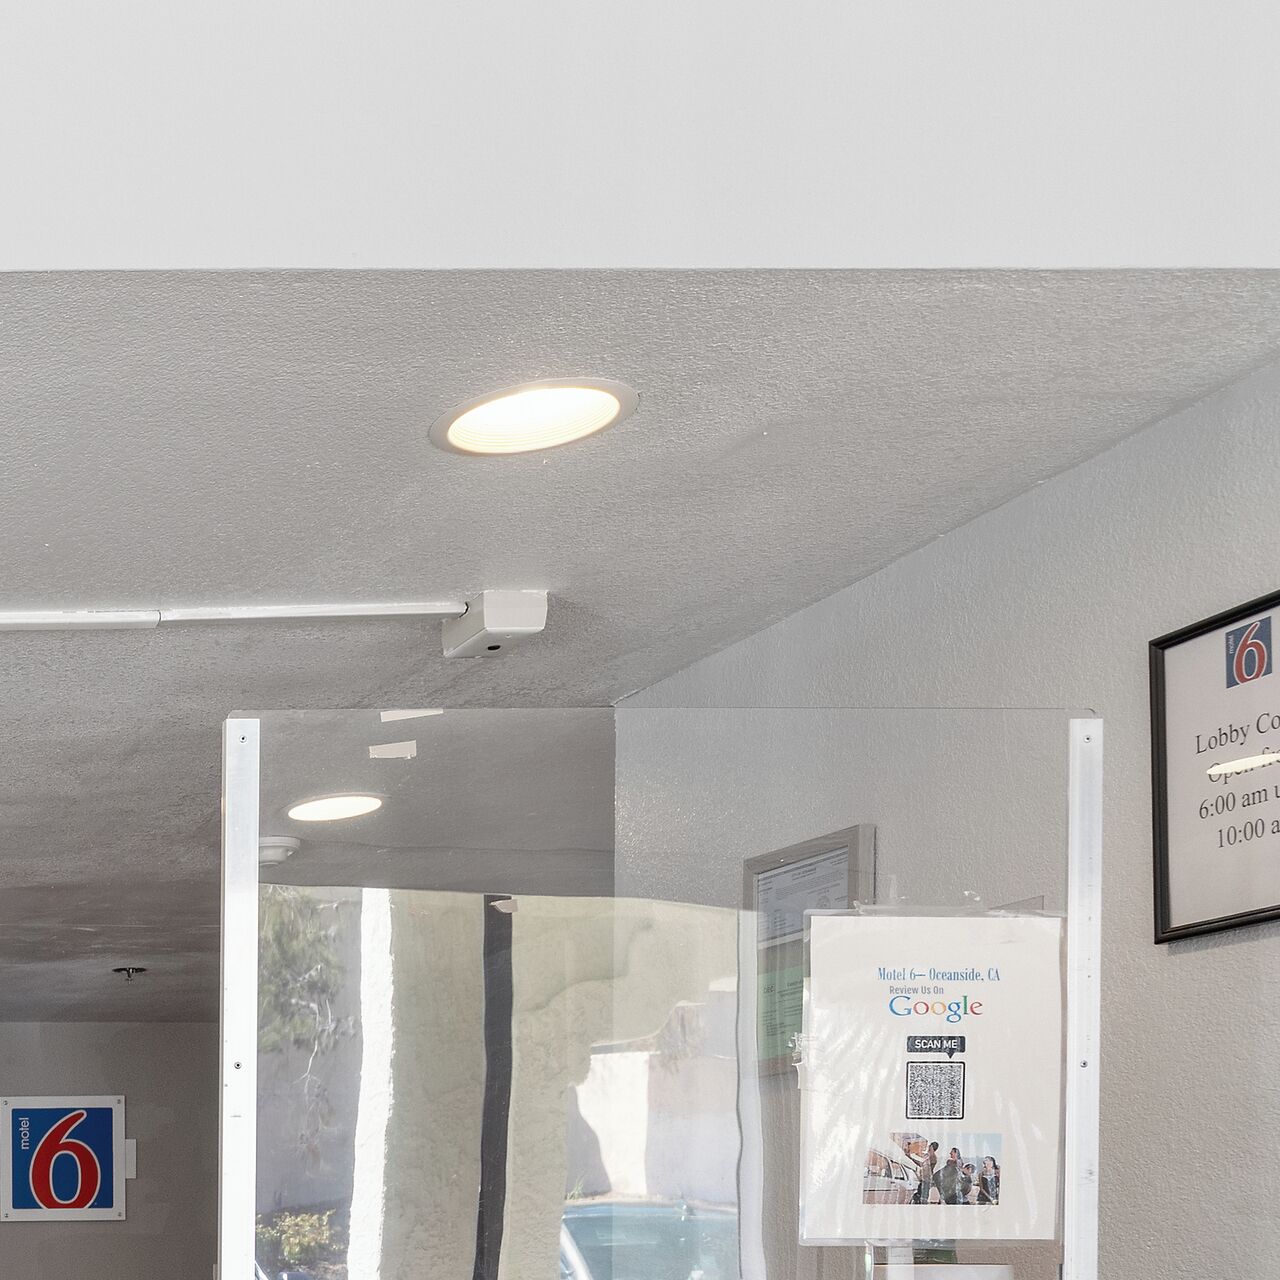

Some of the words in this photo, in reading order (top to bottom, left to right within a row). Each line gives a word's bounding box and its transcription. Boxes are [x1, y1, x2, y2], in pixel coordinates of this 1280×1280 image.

[1233, 621, 1268, 685] 6
[1195, 723, 1251, 755] Lobby
[1199, 791, 1236, 819] 6:00
[1241, 788, 1269, 808] am
[1218, 818, 1265, 848] 10:00
[878, 967, 906, 981] Motel
[988, 968, 1000, 981] CA
[889, 985, 918, 994] Review
[921, 986, 931, 994] Us
[933, 986, 944, 994] On
[889, 995, 983, 1023] Google
[915, 1039, 941, 1049] SCAN
[943, 1039, 958, 1049] ME
[20, 1116, 30, 1151] motel
[28, 1109, 102, 1209] 6
